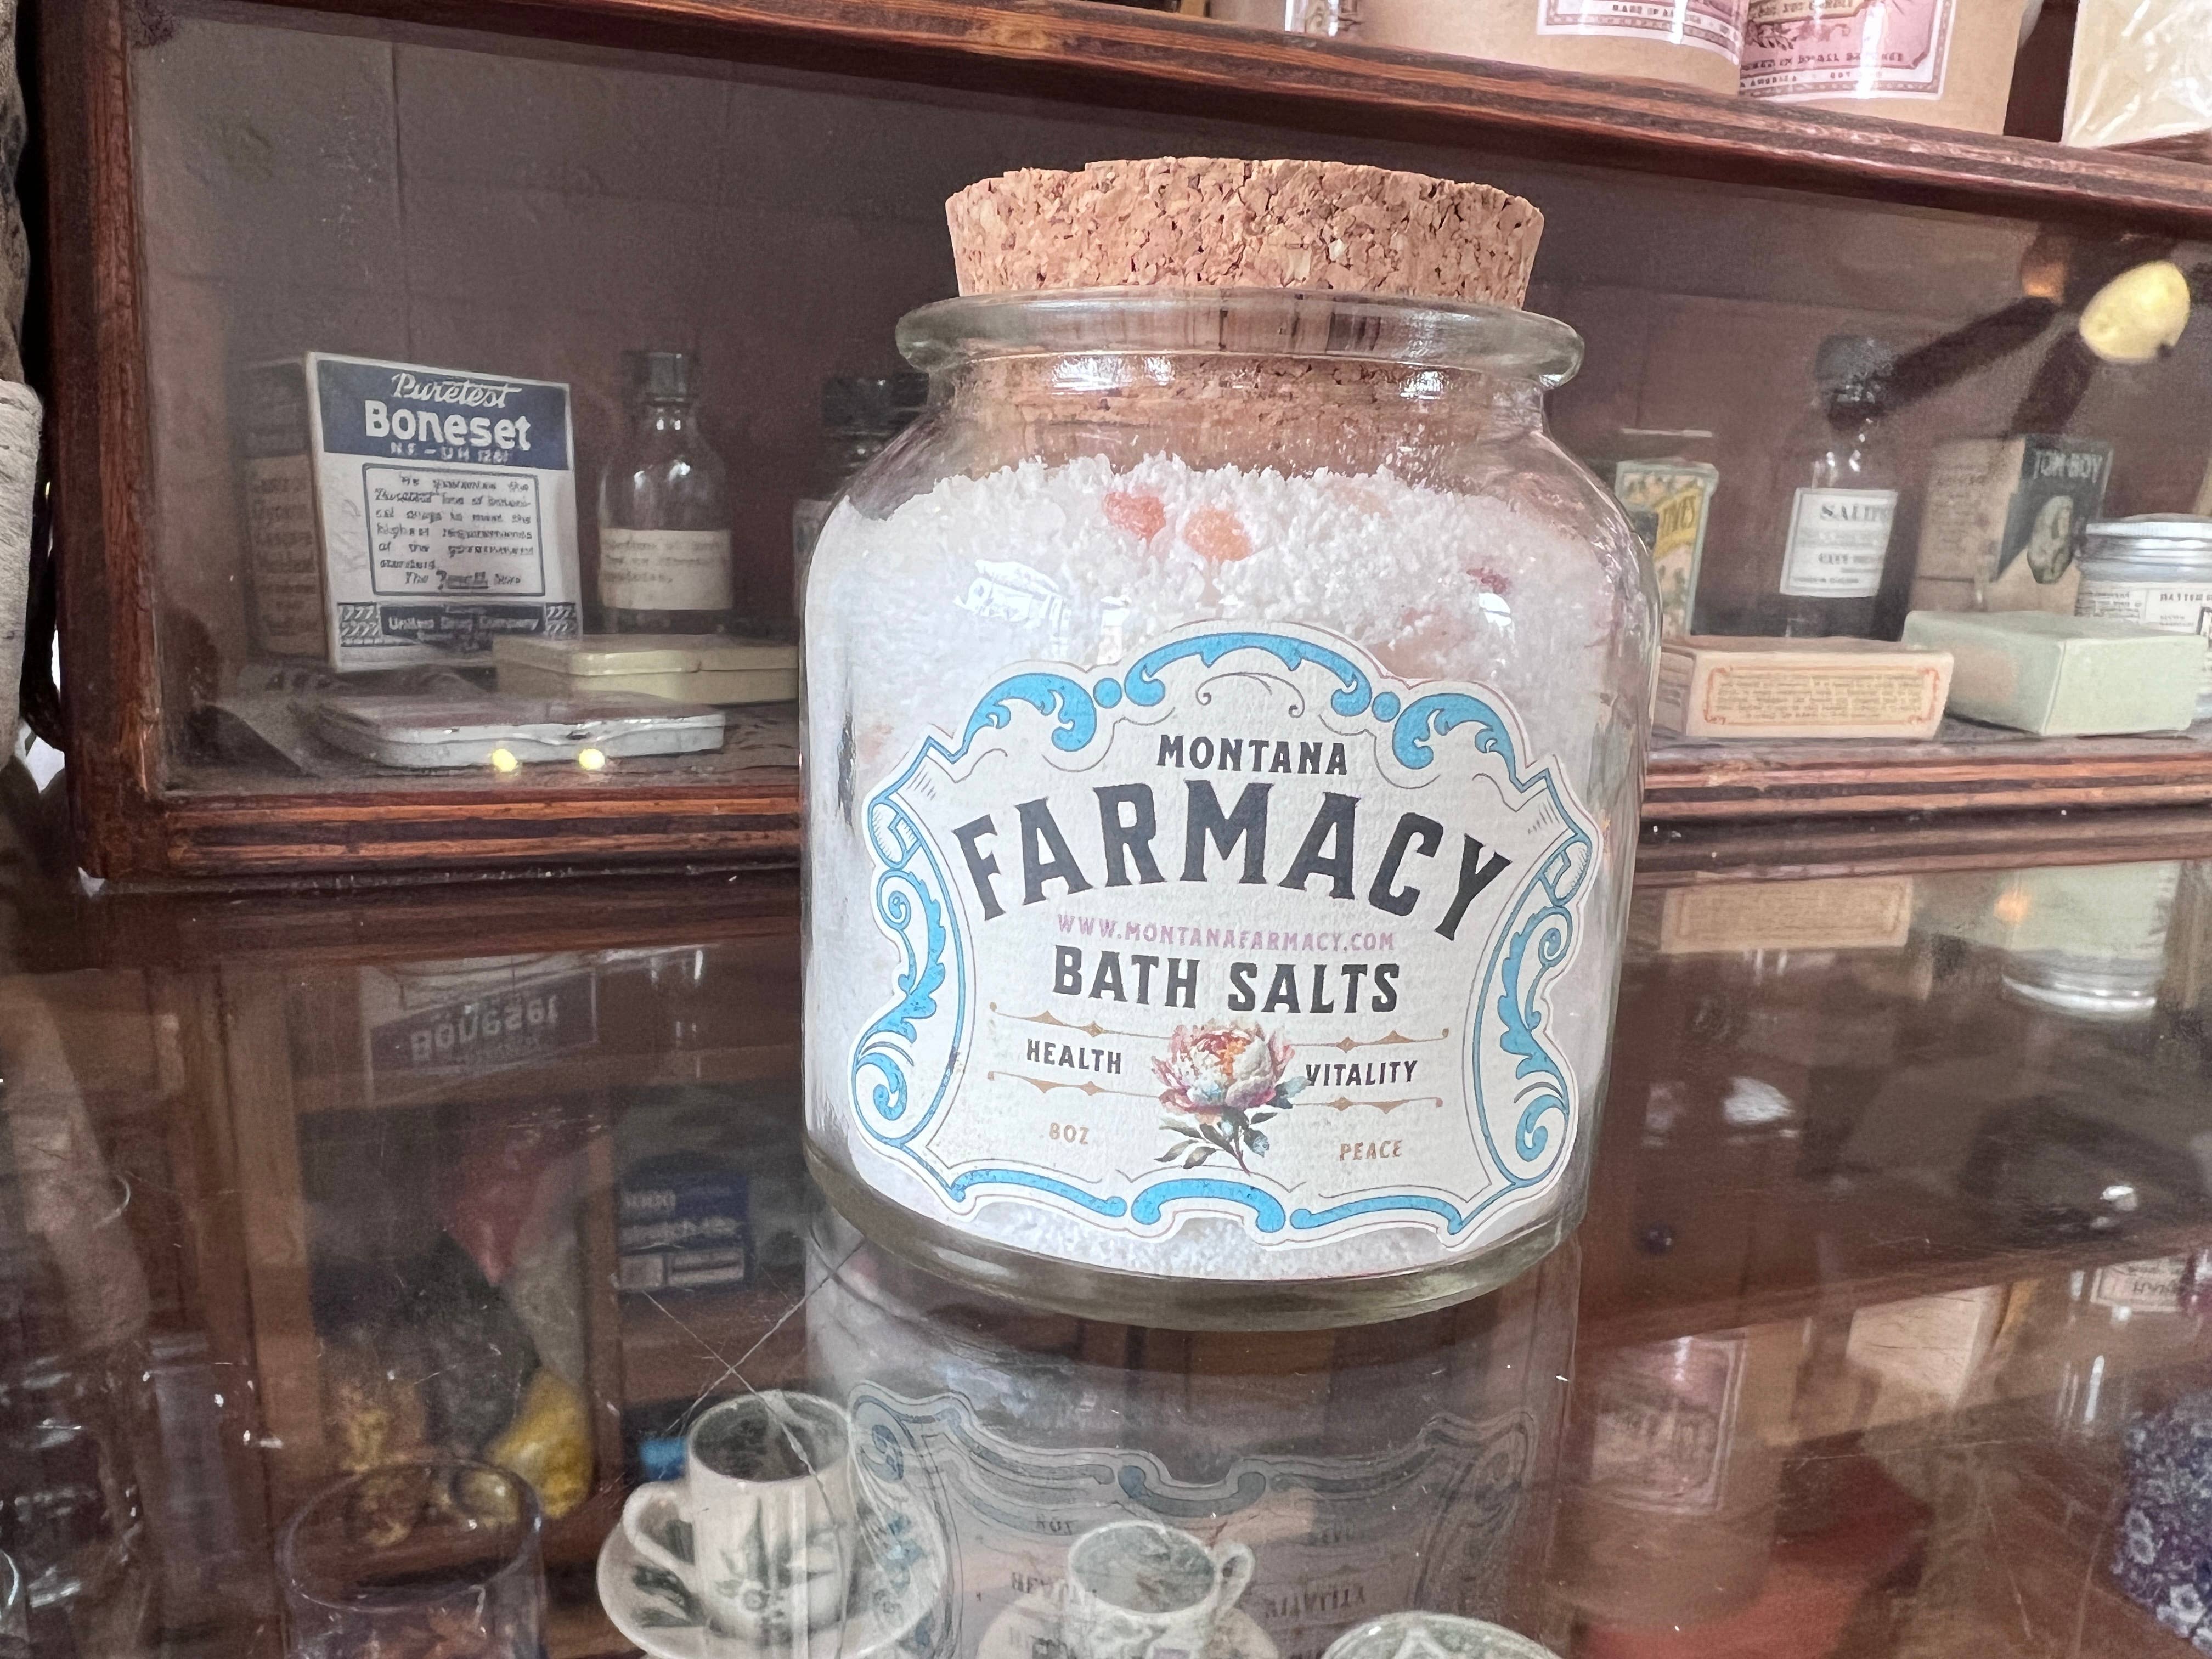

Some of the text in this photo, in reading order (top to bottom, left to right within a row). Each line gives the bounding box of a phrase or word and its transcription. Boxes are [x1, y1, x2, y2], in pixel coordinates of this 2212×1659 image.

[391, 373, 522, 408] Puretest
[364, 400, 531, 451] Boneset
[1156, 734, 1348, 776] MONTANA
[952, 780, 1512, 941] FARMACY
[1057, 913, 1394, 952] WWW.MONTANAFARMACY.COM
[1053, 945, 1400, 1013] BATH SALTS
[1026, 1038, 1418, 1087] HEALTH VITALITY
[1339, 1139, 1403, 1162] PEACE
